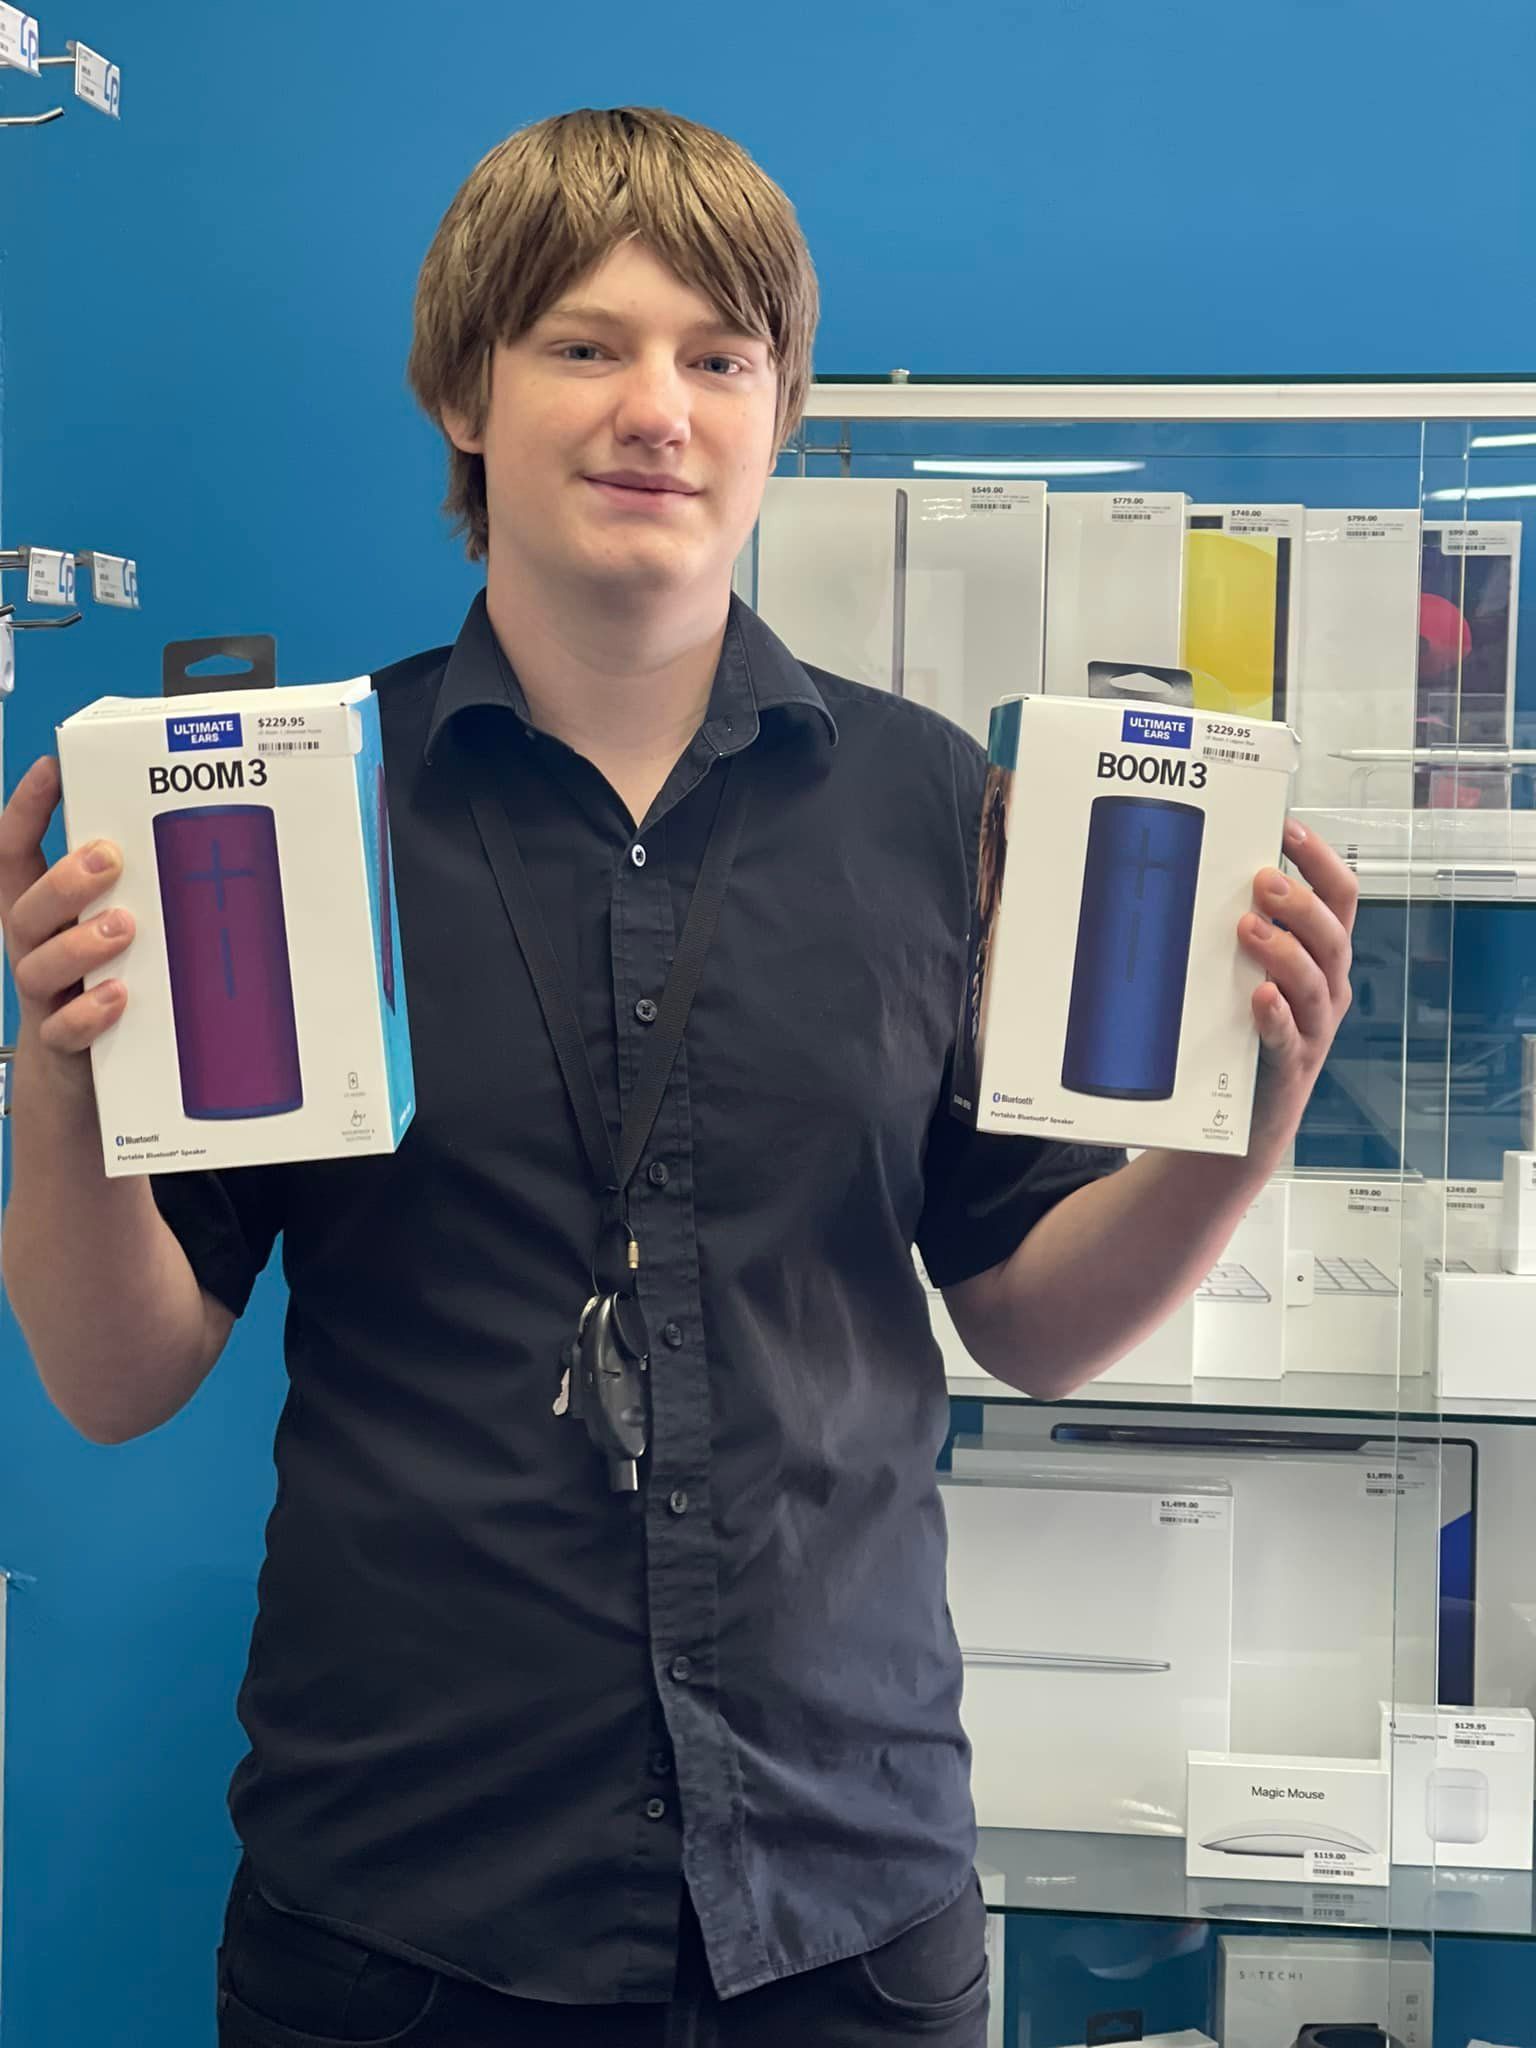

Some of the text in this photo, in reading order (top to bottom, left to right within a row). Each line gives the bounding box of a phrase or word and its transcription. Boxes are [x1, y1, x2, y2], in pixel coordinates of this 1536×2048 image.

[173, 720, 235, 736] ULTIMATE
[257, 716, 306, 728] $229.95
[1129, 716, 1187, 733] ULTIMATE
[1143, 729, 1171, 741] EARS
[1206, 723, 1252, 739] $229.95
[190, 733, 220, 745] EARS
[1096, 751, 1208, 789] BOOM 3
[149, 758, 268, 795] BOOM 3
[1001, 1094, 1033, 1105] Bluetooth
[125, 1134, 159, 1145] Bluetooth
[1455, 1722, 1487, 1730] $129.95
[1251, 1786, 1325, 1800] Magic Mouse
[1314, 1852, 1346, 1860] $119.00
